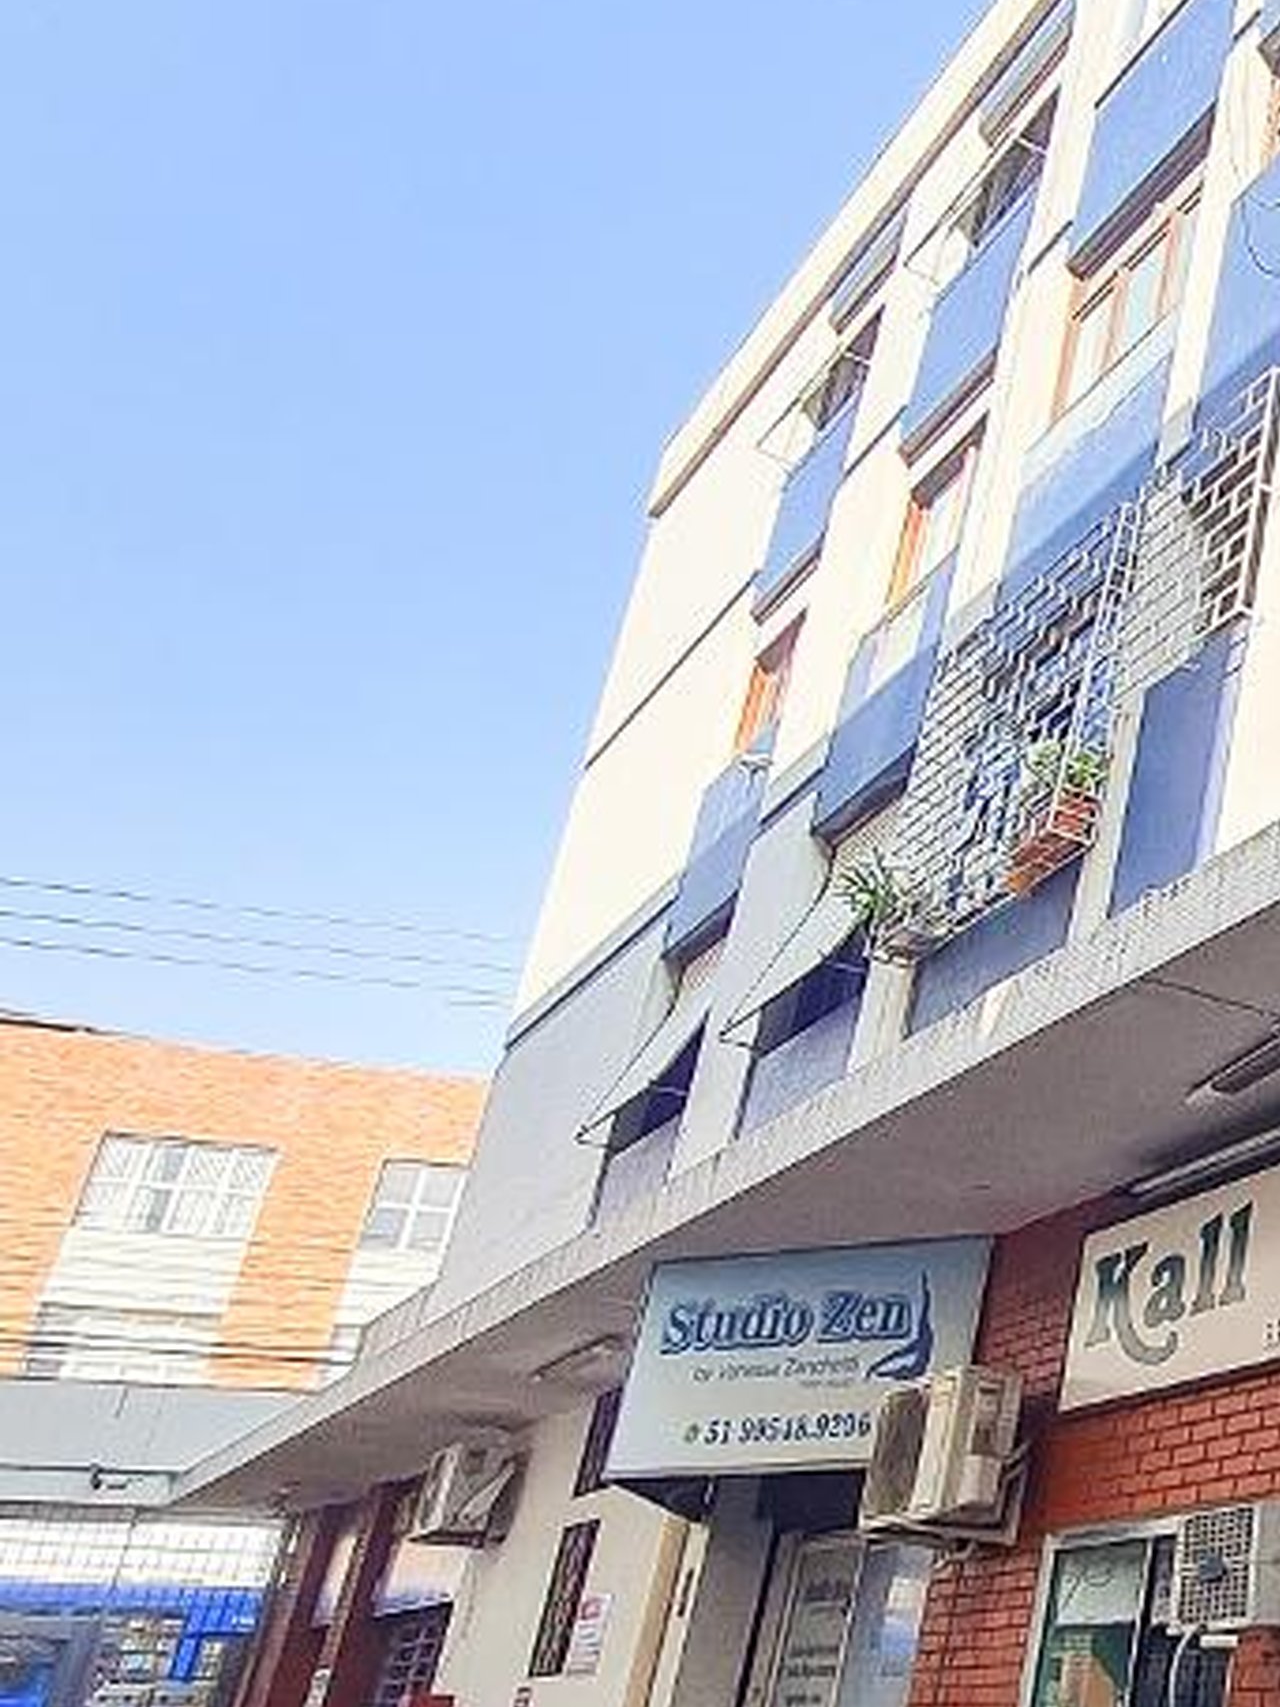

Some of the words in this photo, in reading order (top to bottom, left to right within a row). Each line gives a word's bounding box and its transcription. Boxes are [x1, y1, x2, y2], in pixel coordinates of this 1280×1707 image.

[1084, 1202, 1256, 1366] Kall
[660, 1292, 814, 1355] Studio
[818, 1288, 913, 1343] Zen
[704, 1417, 731, 1445] 51
